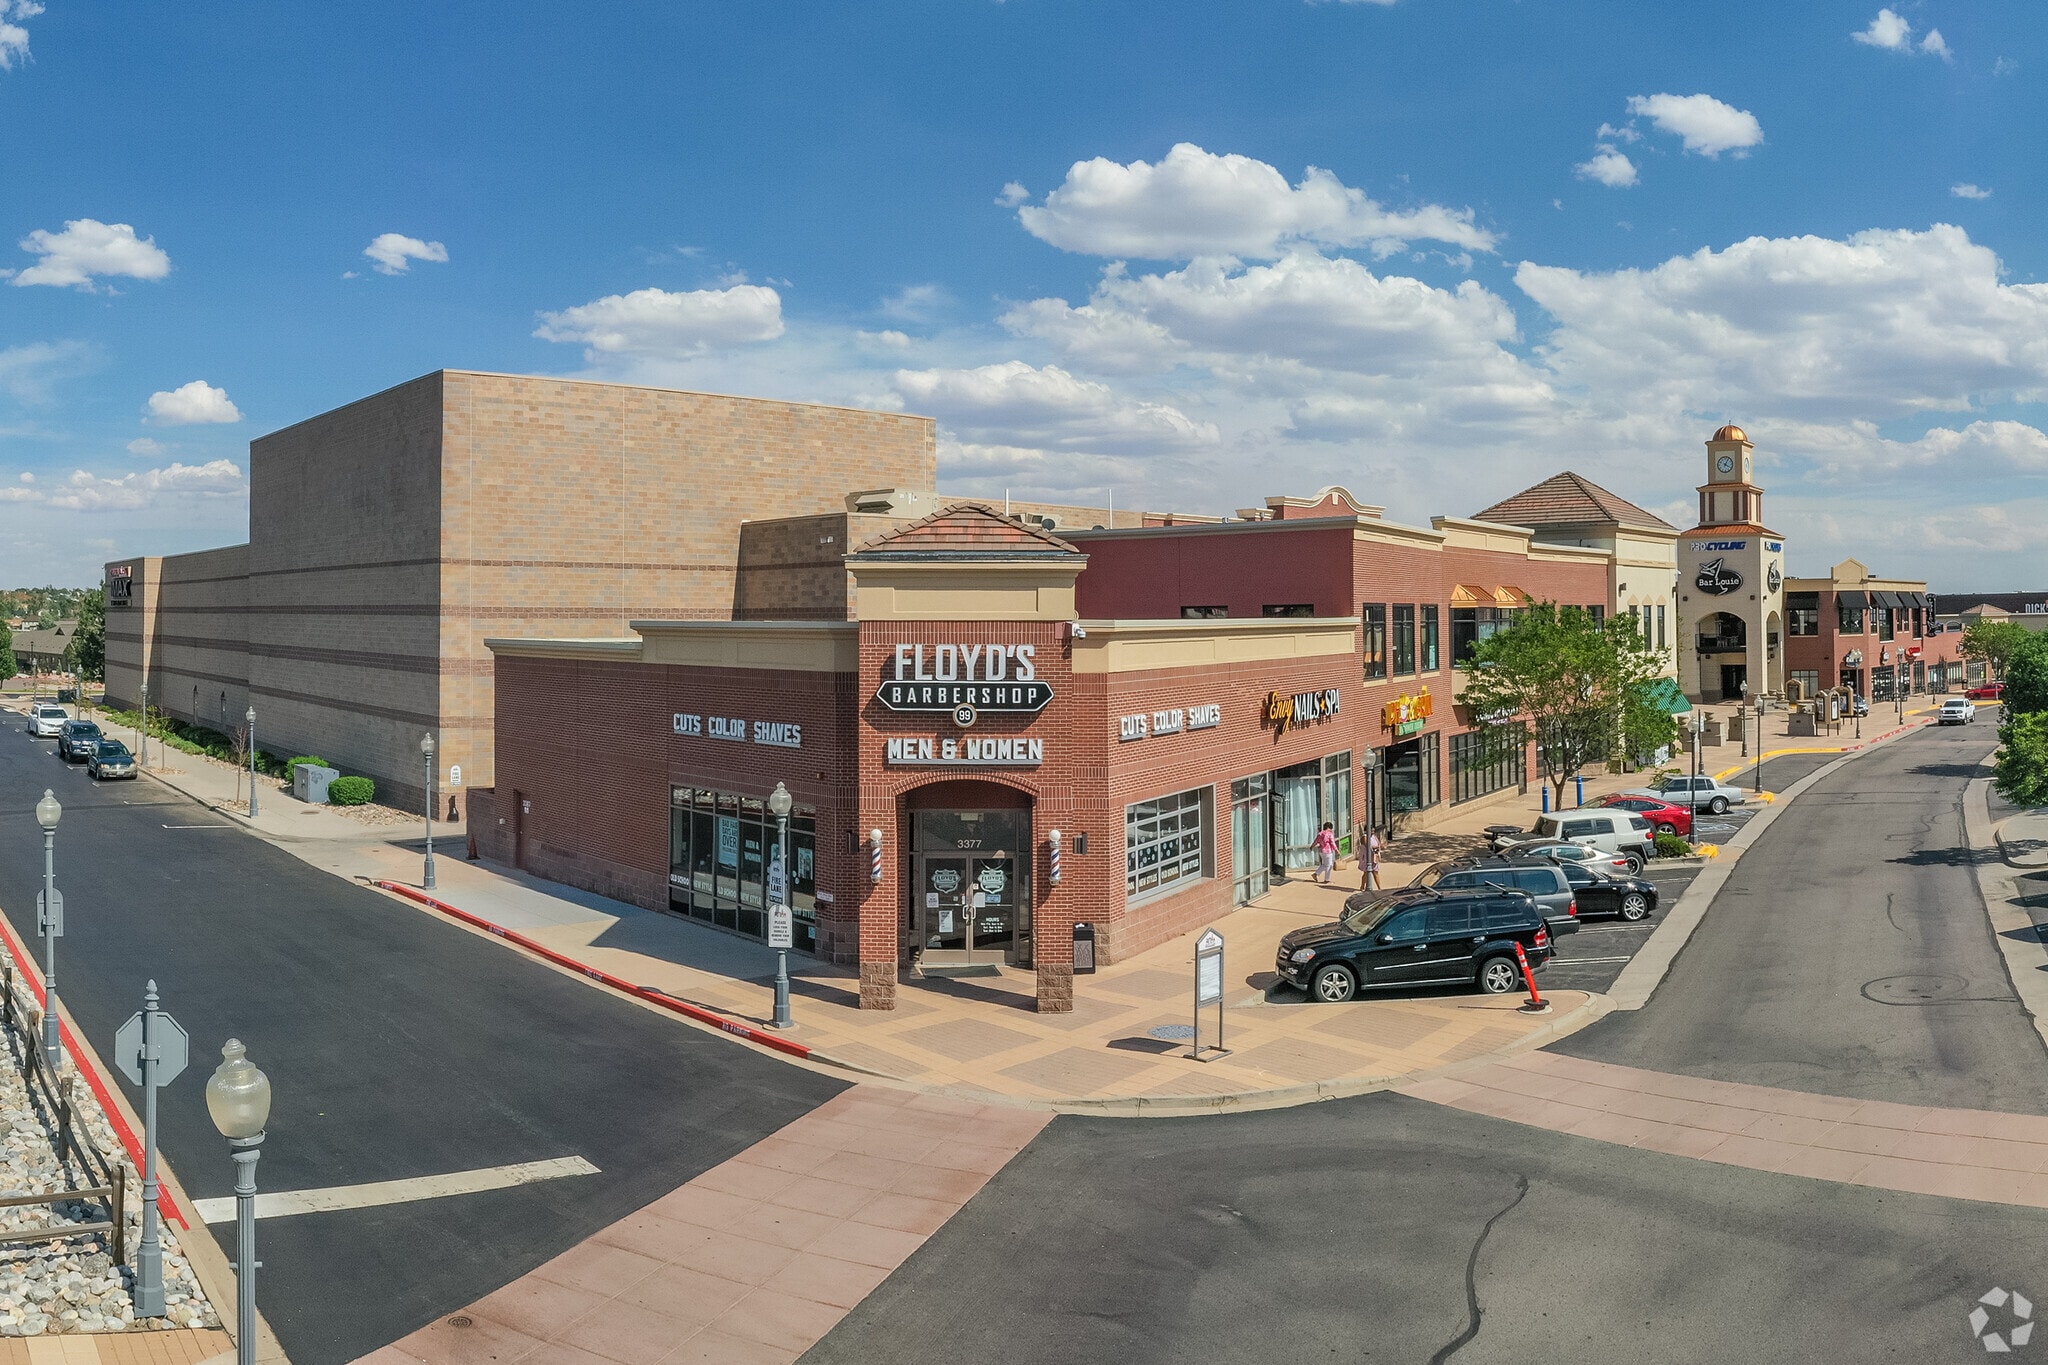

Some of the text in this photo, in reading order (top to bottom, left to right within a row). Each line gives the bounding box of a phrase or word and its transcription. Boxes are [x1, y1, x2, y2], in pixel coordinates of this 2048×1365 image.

[1698, 577, 1740, 587] Bar Louie
[2025, 603, 2048, 614] DICK
[895, 643, 1036, 682] FLOYD'S
[892, 687, 1038, 705] BARBERSHOP
[958, 710, 972, 722] 99
[1120, 703, 1221, 736] CUTS COLOR SHAVES
[1269, 688, 1341, 736] Envy NAILS SPA
[673, 713, 801, 744] CUTS COLOR SHAVES
[887, 738, 1044, 760] MEN & WOMEN
[722, 835, 737, 848] OVER
[957, 839, 983, 849] 3377
[677, 875, 690, 886] SCHOO
[770, 876, 782, 894] FIRE LANE
[723, 887, 737, 898] SCHOO
